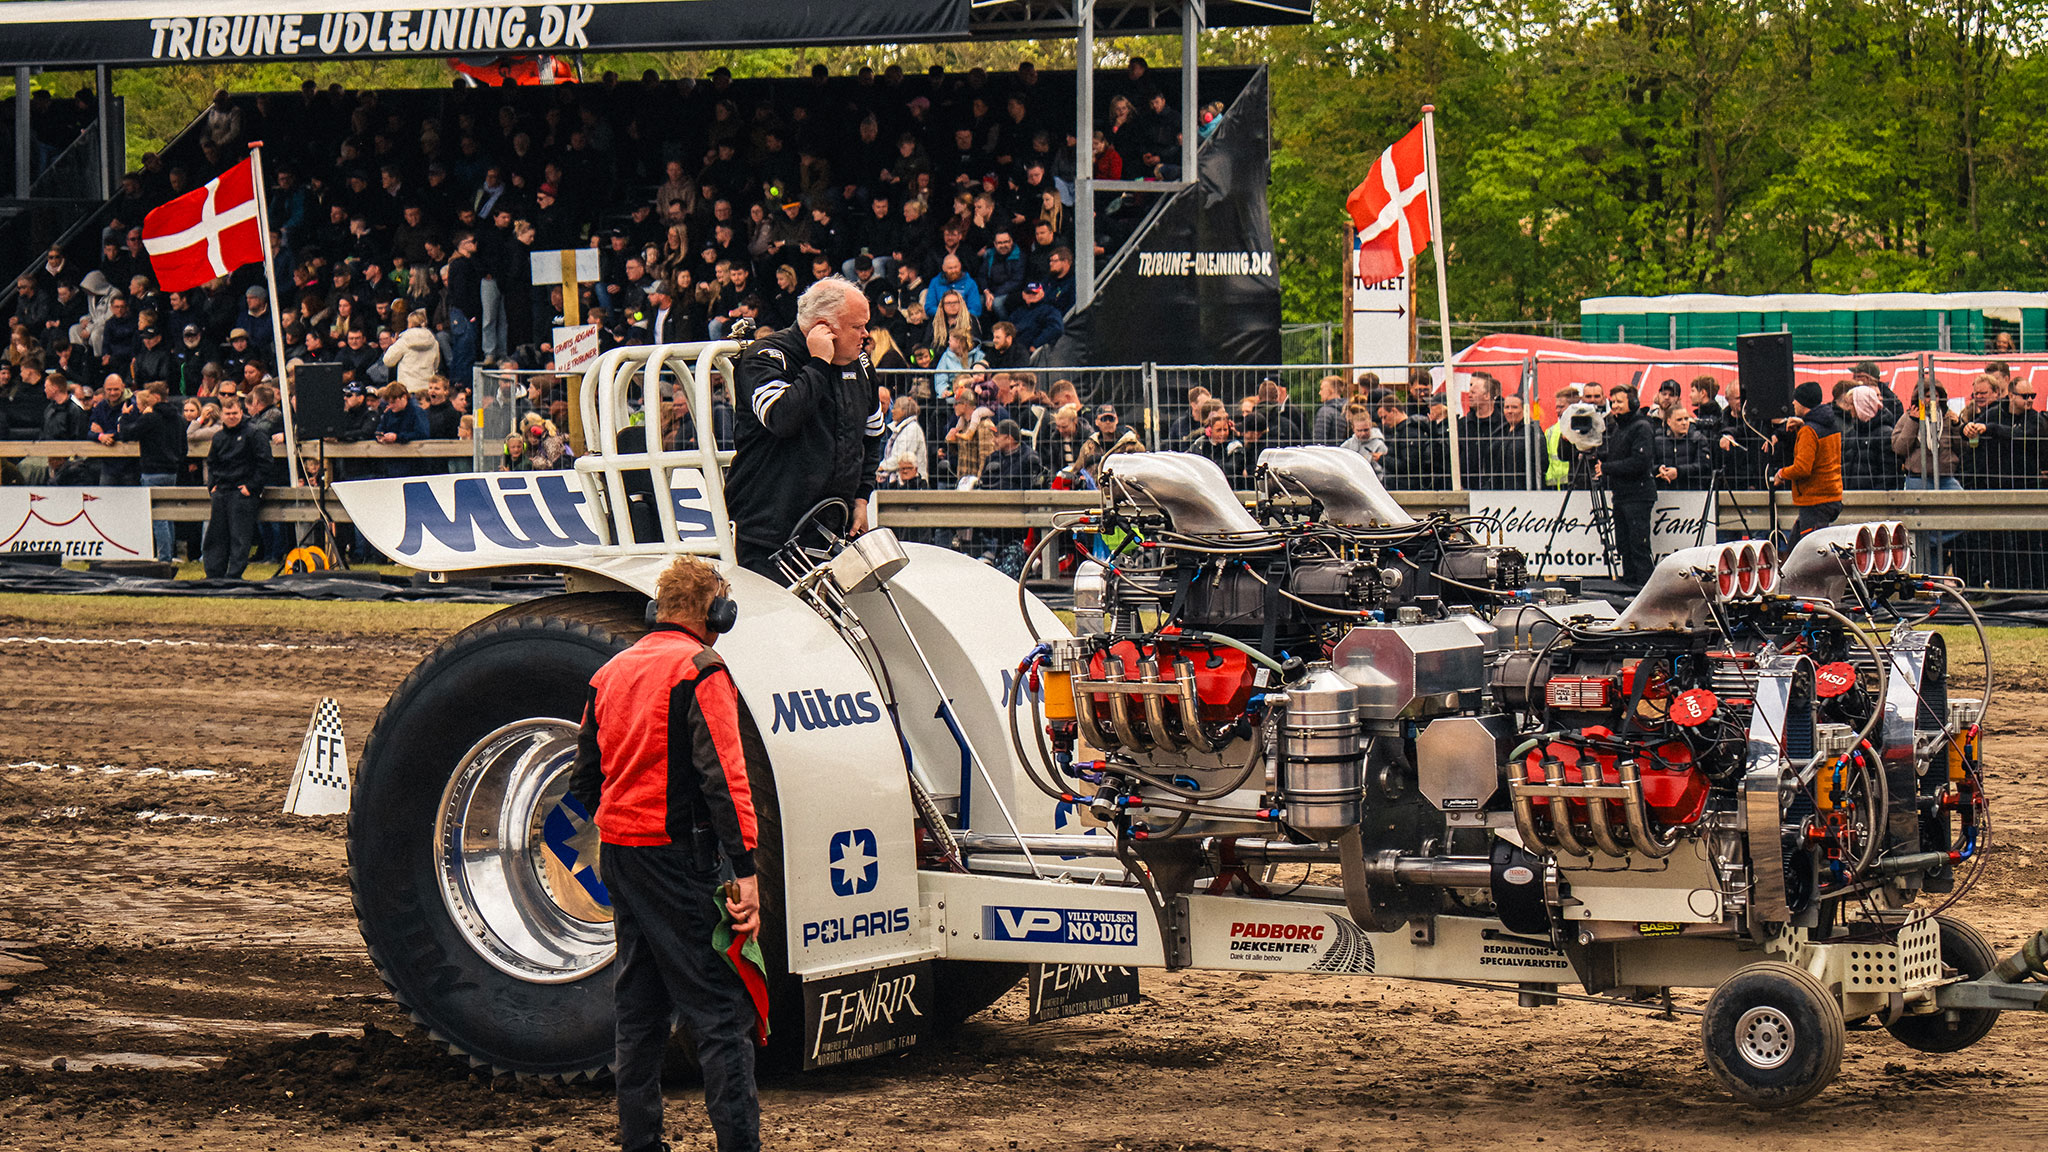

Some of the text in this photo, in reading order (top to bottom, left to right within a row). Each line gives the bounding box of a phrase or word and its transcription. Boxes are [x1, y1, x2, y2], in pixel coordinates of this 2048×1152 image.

[150, 3, 595, 60] TRIBUNE-UDLEJNING.DK
[1353, 275, 1405, 291] TOILET
[395, 474, 718, 557] Mits
[1475, 506, 1580, 535] Welcome
[65, 541, 104, 557] TELTE
[1818, 671, 1847, 686] MSD
[771, 688, 881, 735] Mitas
[1683, 695, 1702, 718] MSD
[316, 735, 342, 773] FF
[802, 907, 910, 948] POLARIS
[996, 908, 1063, 939] VP
[1067, 911, 1134, 924] VILLY POULSEN
[1640, 922, 1681, 932] SASSY
[1067, 922, 1136, 944] NO-DIG
[1230, 922, 1325, 941] PADBORG
[1230, 941, 1310, 954] DÆKCENTER
[1252, 953, 1263, 961] alle
[1264, 954, 1283, 962] behov
[1479, 956, 1568, 969] SPECIALVÆRKSTED
[811, 973, 924, 1060] FENRIR
[1061, 1002, 1087, 1017] TRACTOR
[1088, 996, 1112, 1012] PULLING
[1113, 993, 1128, 1006] TEAM
[816, 1034, 917, 1067] NORDIC TRACTOR PULLING TEAM
